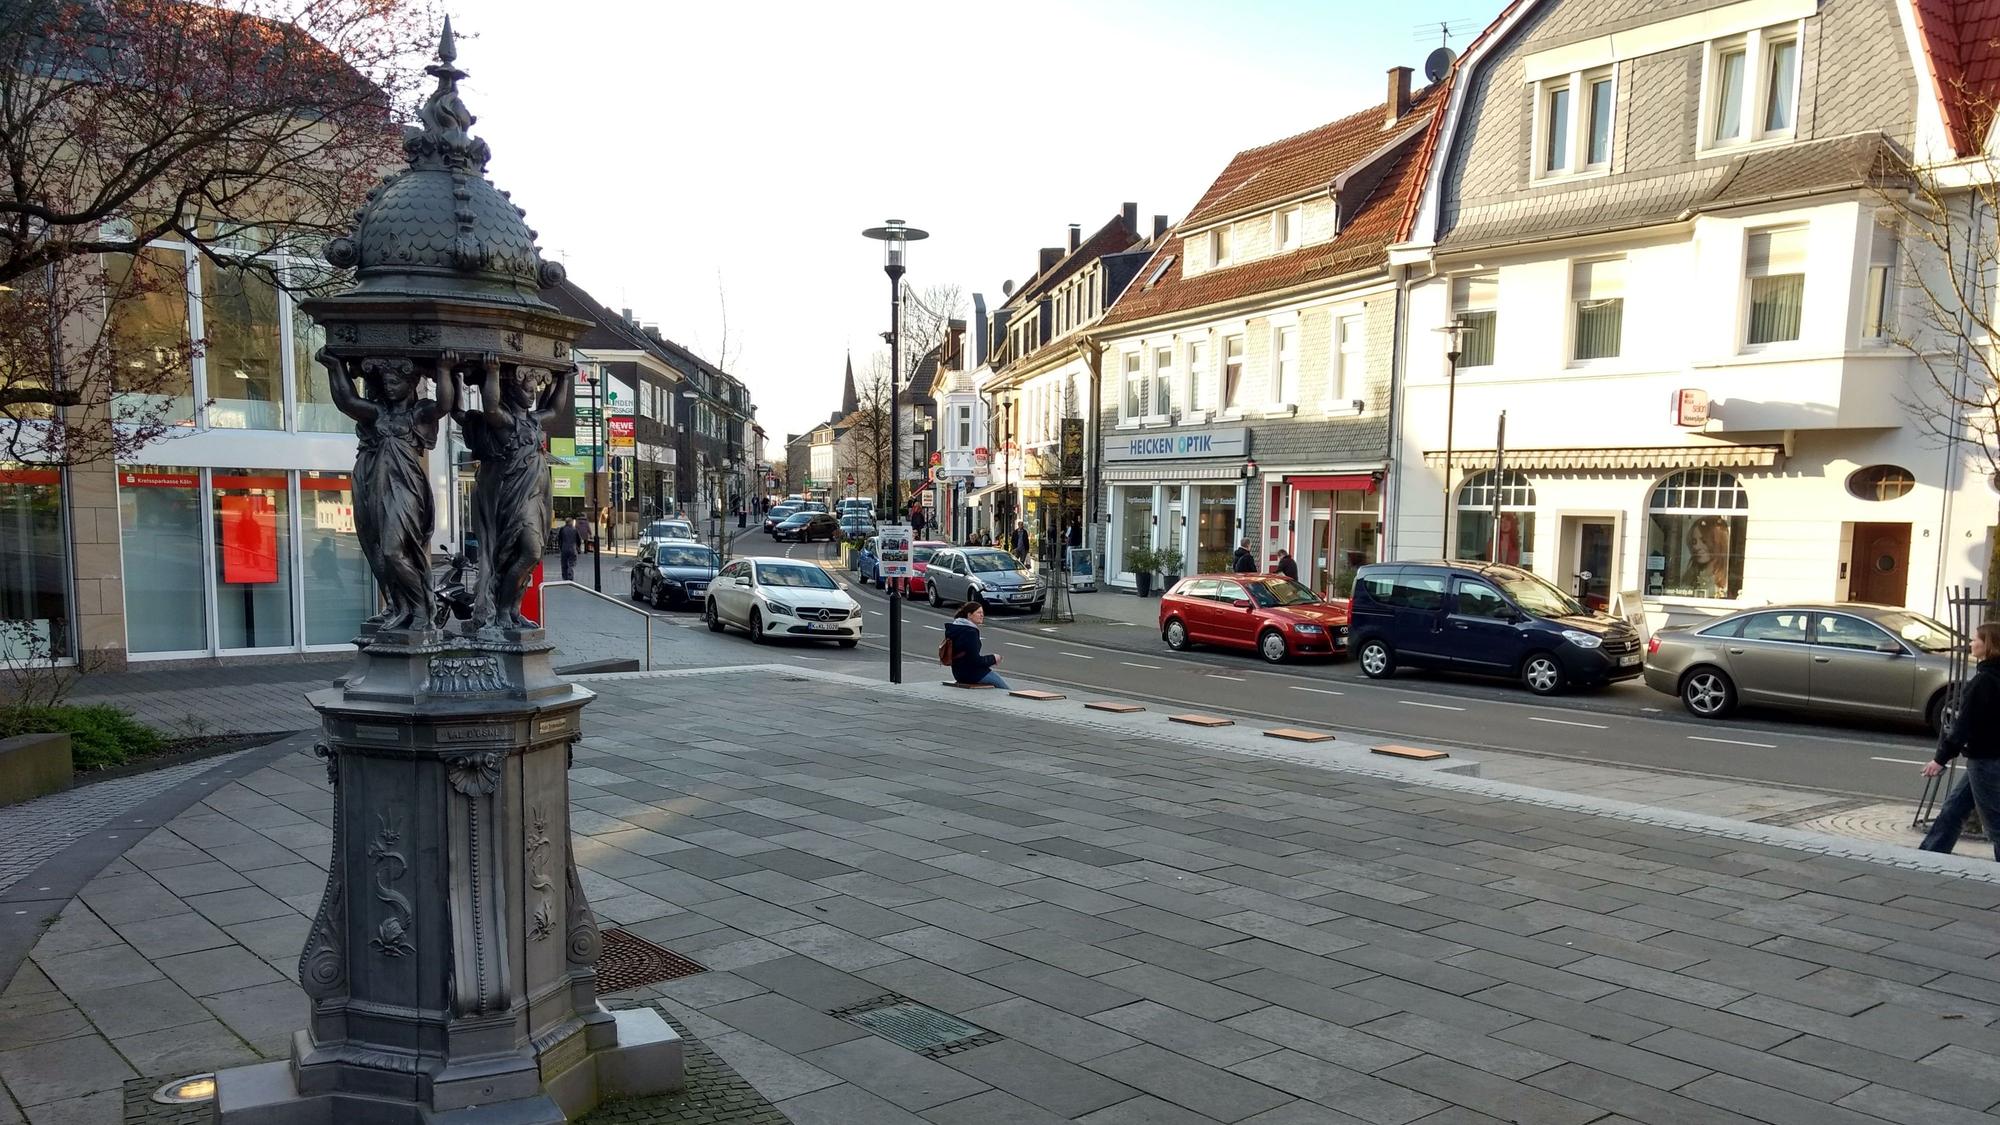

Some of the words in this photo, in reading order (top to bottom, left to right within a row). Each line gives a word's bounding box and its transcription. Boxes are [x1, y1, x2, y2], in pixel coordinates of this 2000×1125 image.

[609, 421, 634, 430] REWE
[1130, 438, 1174, 455] HEICKEN
[1177, 435, 1212, 454] OPTIK
[1922, 529, 1930, 538] 8
[1965, 530, 1973, 538] 6
[447, 728, 464, 740] VAL
